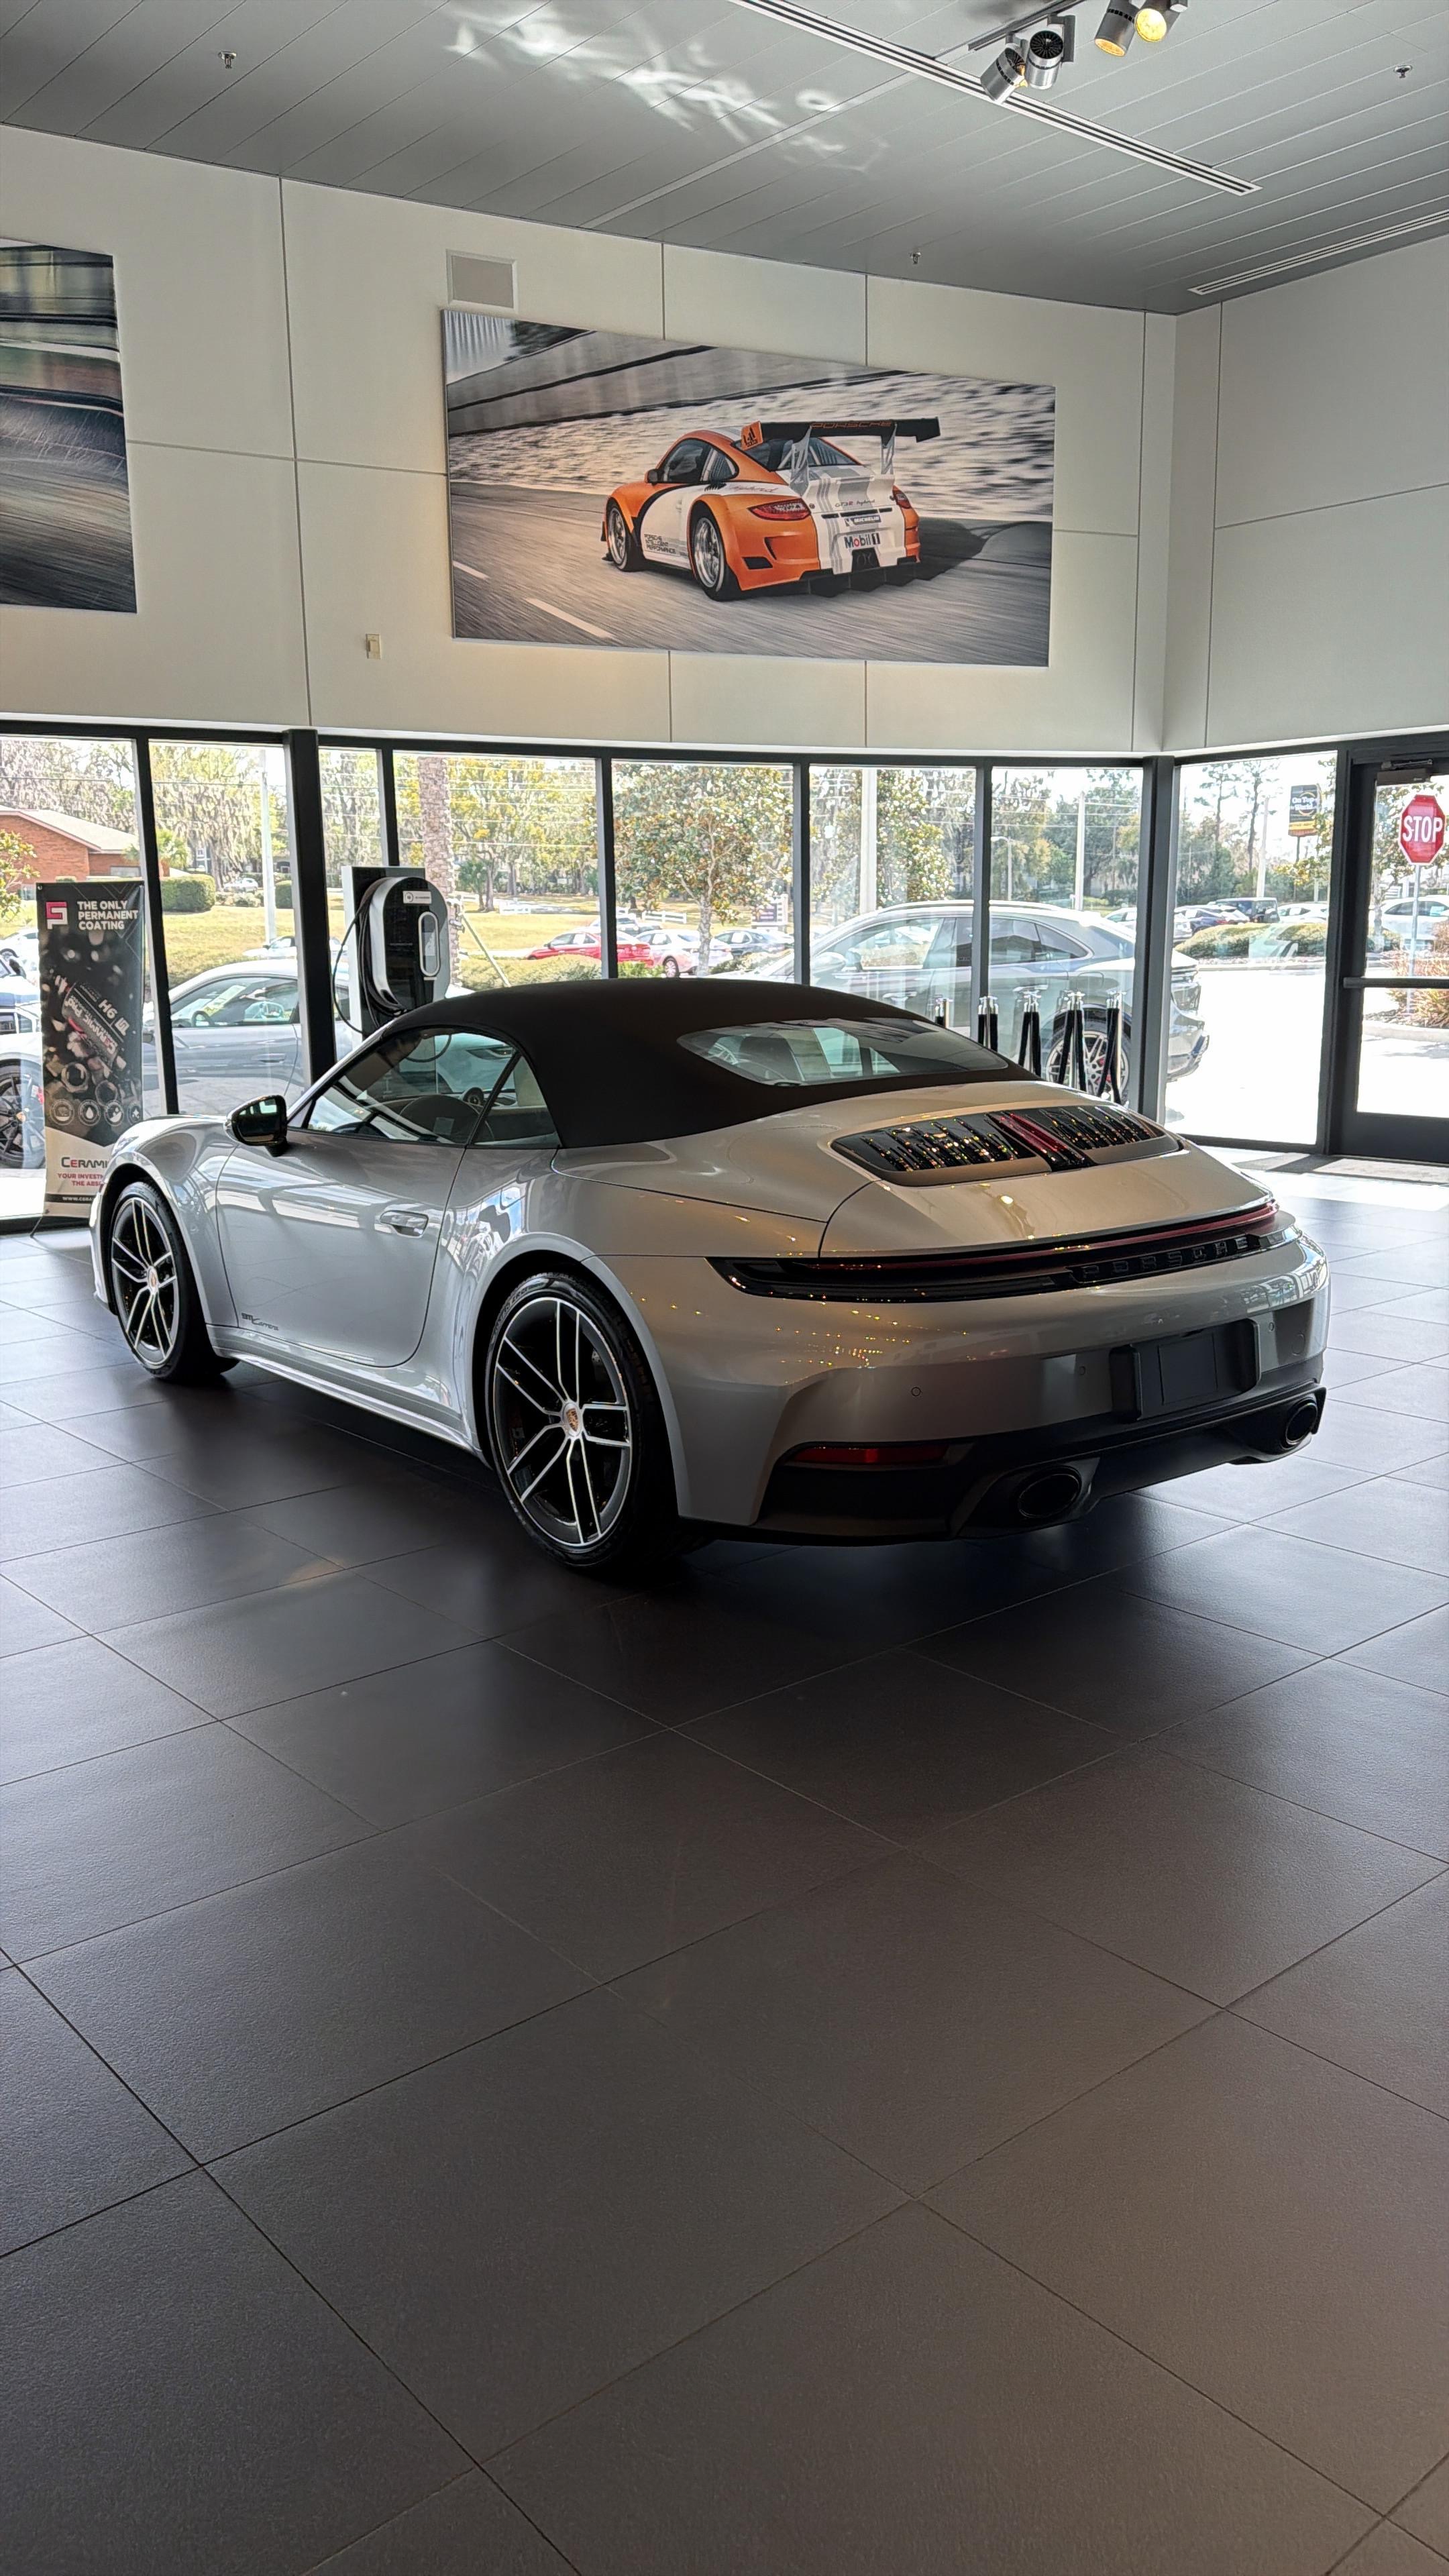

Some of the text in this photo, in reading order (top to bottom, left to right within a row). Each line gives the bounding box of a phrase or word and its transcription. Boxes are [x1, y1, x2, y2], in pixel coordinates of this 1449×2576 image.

[810, 421, 892, 429] PORSCHE
[845, 533, 871, 548] Mobil
[1403, 815, 1443, 843] STOP
[77, 900, 128, 910] THE ONLY
[78, 910, 139, 920] PERMANENT
[78, 920, 125, 930] COATING
[83, 1014, 117, 1055] CERAMIC
[61, 1157, 109, 1169] CERAMI
[1081, 1235, 1248, 1279] PORSCHE
